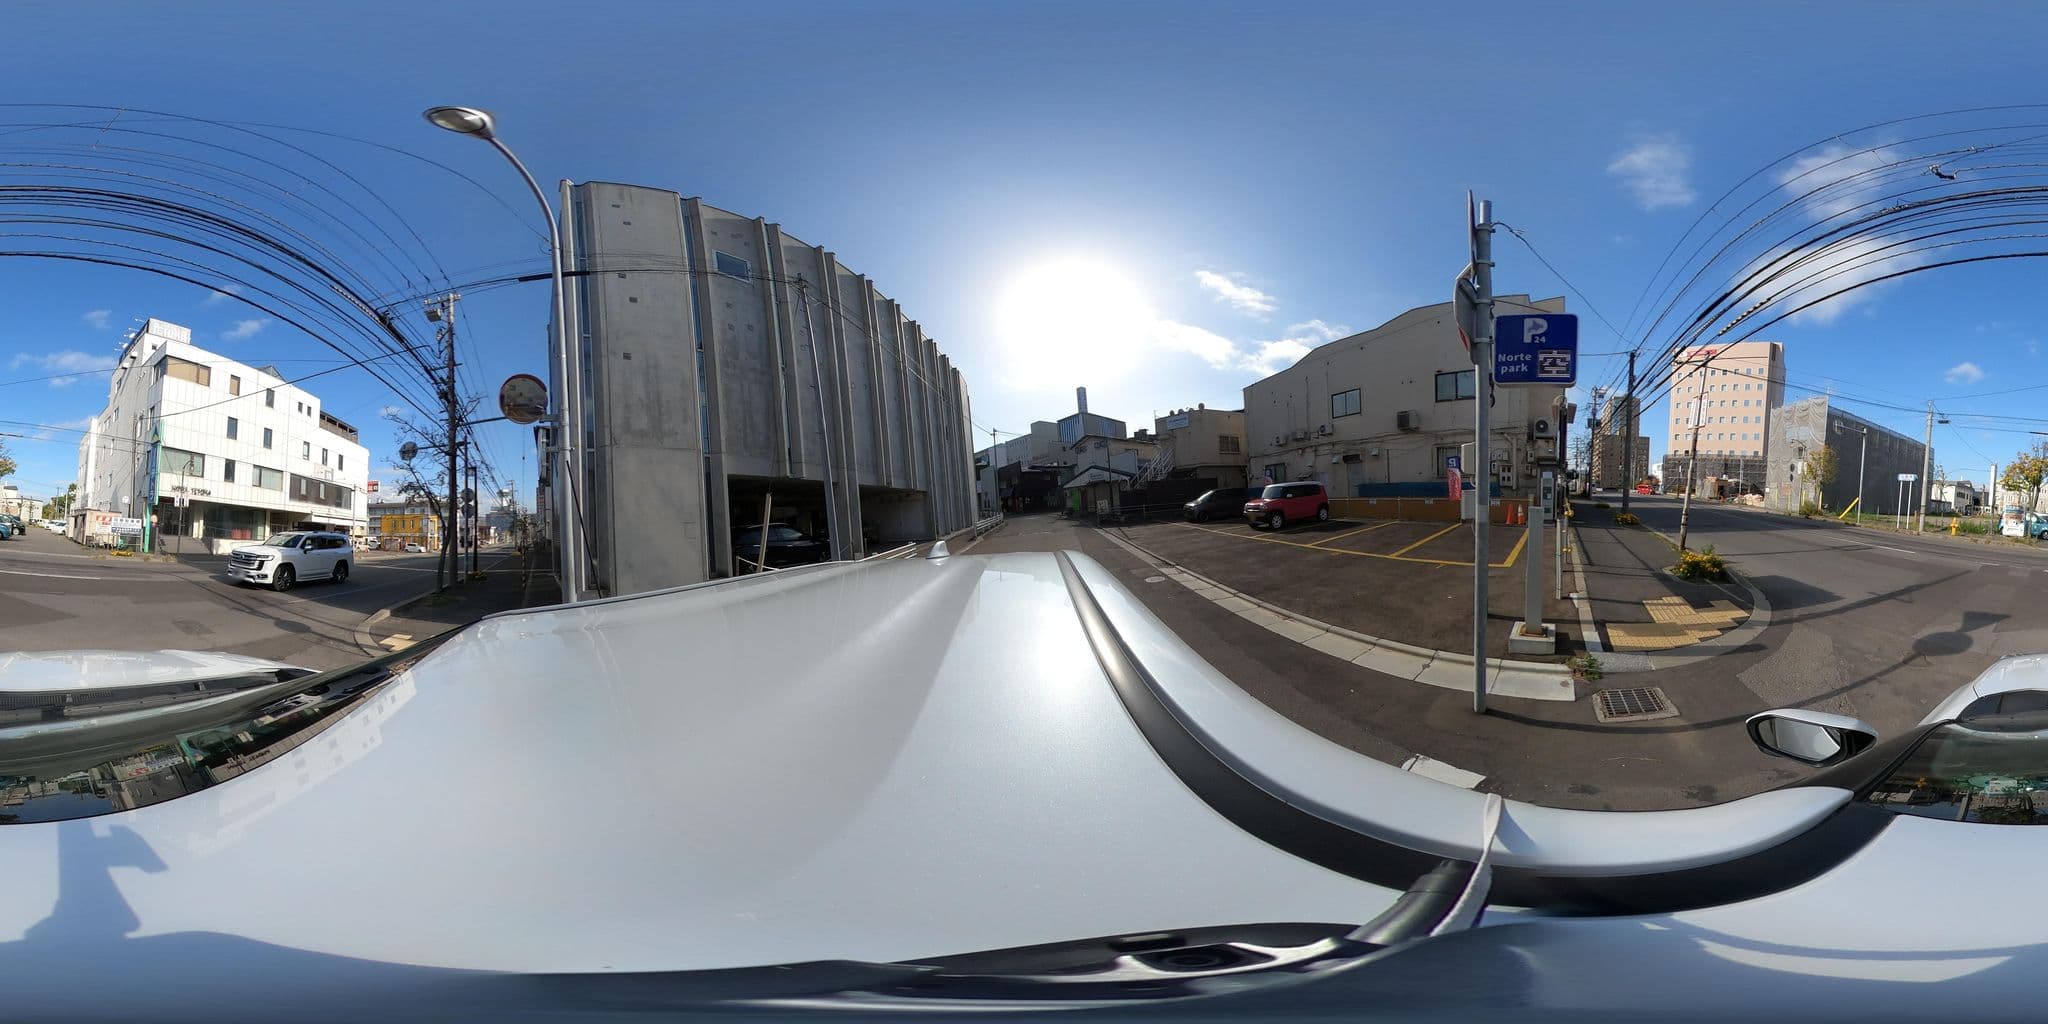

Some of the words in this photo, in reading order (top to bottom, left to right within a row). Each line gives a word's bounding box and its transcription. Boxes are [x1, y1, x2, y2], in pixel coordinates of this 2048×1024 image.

[1523, 318, 1548, 343] P
[1498, 353, 1532, 362] Norte
[1538, 350, 1571, 378] 空
[1501, 363, 1528, 375] park
